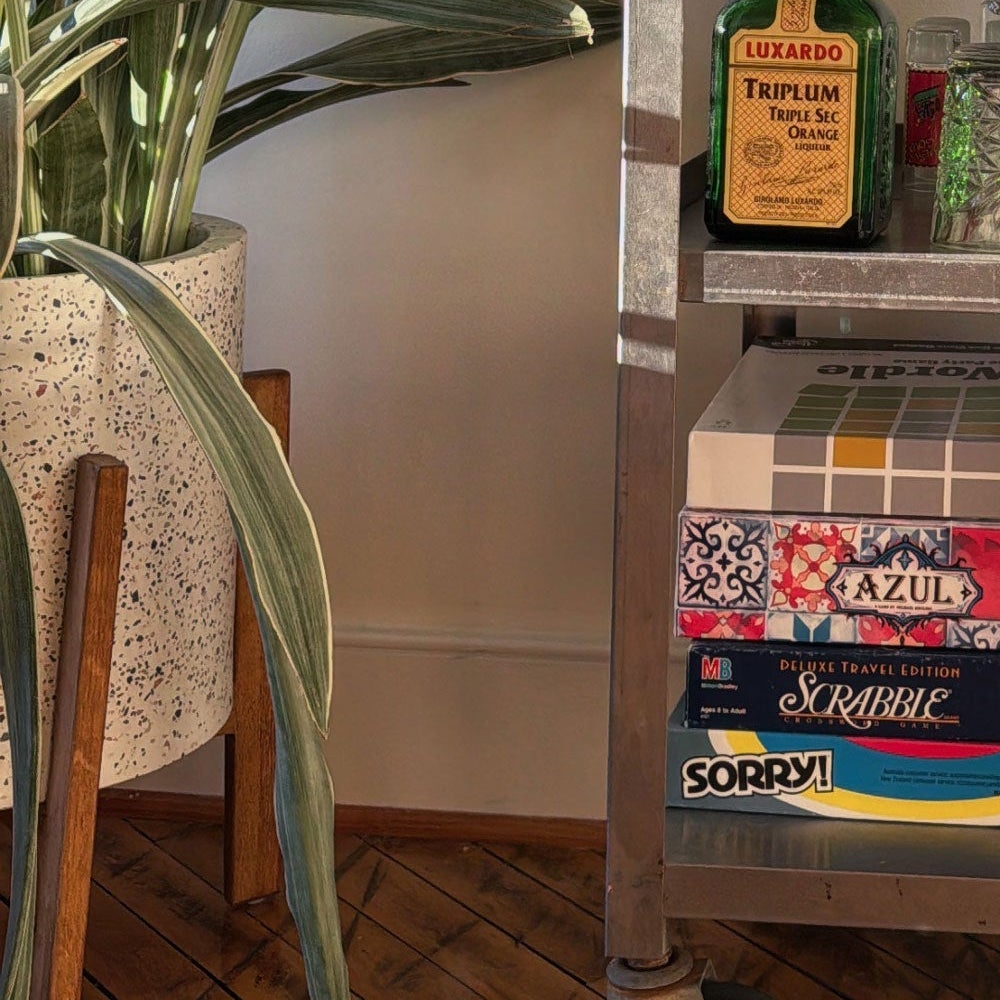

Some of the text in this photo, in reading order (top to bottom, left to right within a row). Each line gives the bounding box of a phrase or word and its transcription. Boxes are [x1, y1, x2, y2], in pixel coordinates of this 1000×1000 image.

[746, 41, 843, 61] LUXARDO
[743, 78, 840, 102] TRIPLUM
[768, 106, 840, 123] TRIPLE SEC
[788, 125, 840, 141] ORANGE
[795, 142, 831, 151] LIQUEUR
[854, 573, 955, 604] AZUL
[701, 656, 732, 681] MB
[780, 659, 960, 678] DELUXE TRAVEL EDITION
[779, 671, 949, 729] SCRABBLE
[900, 721, 941, 730] GAME
[682, 753, 831, 797] SORRY!
